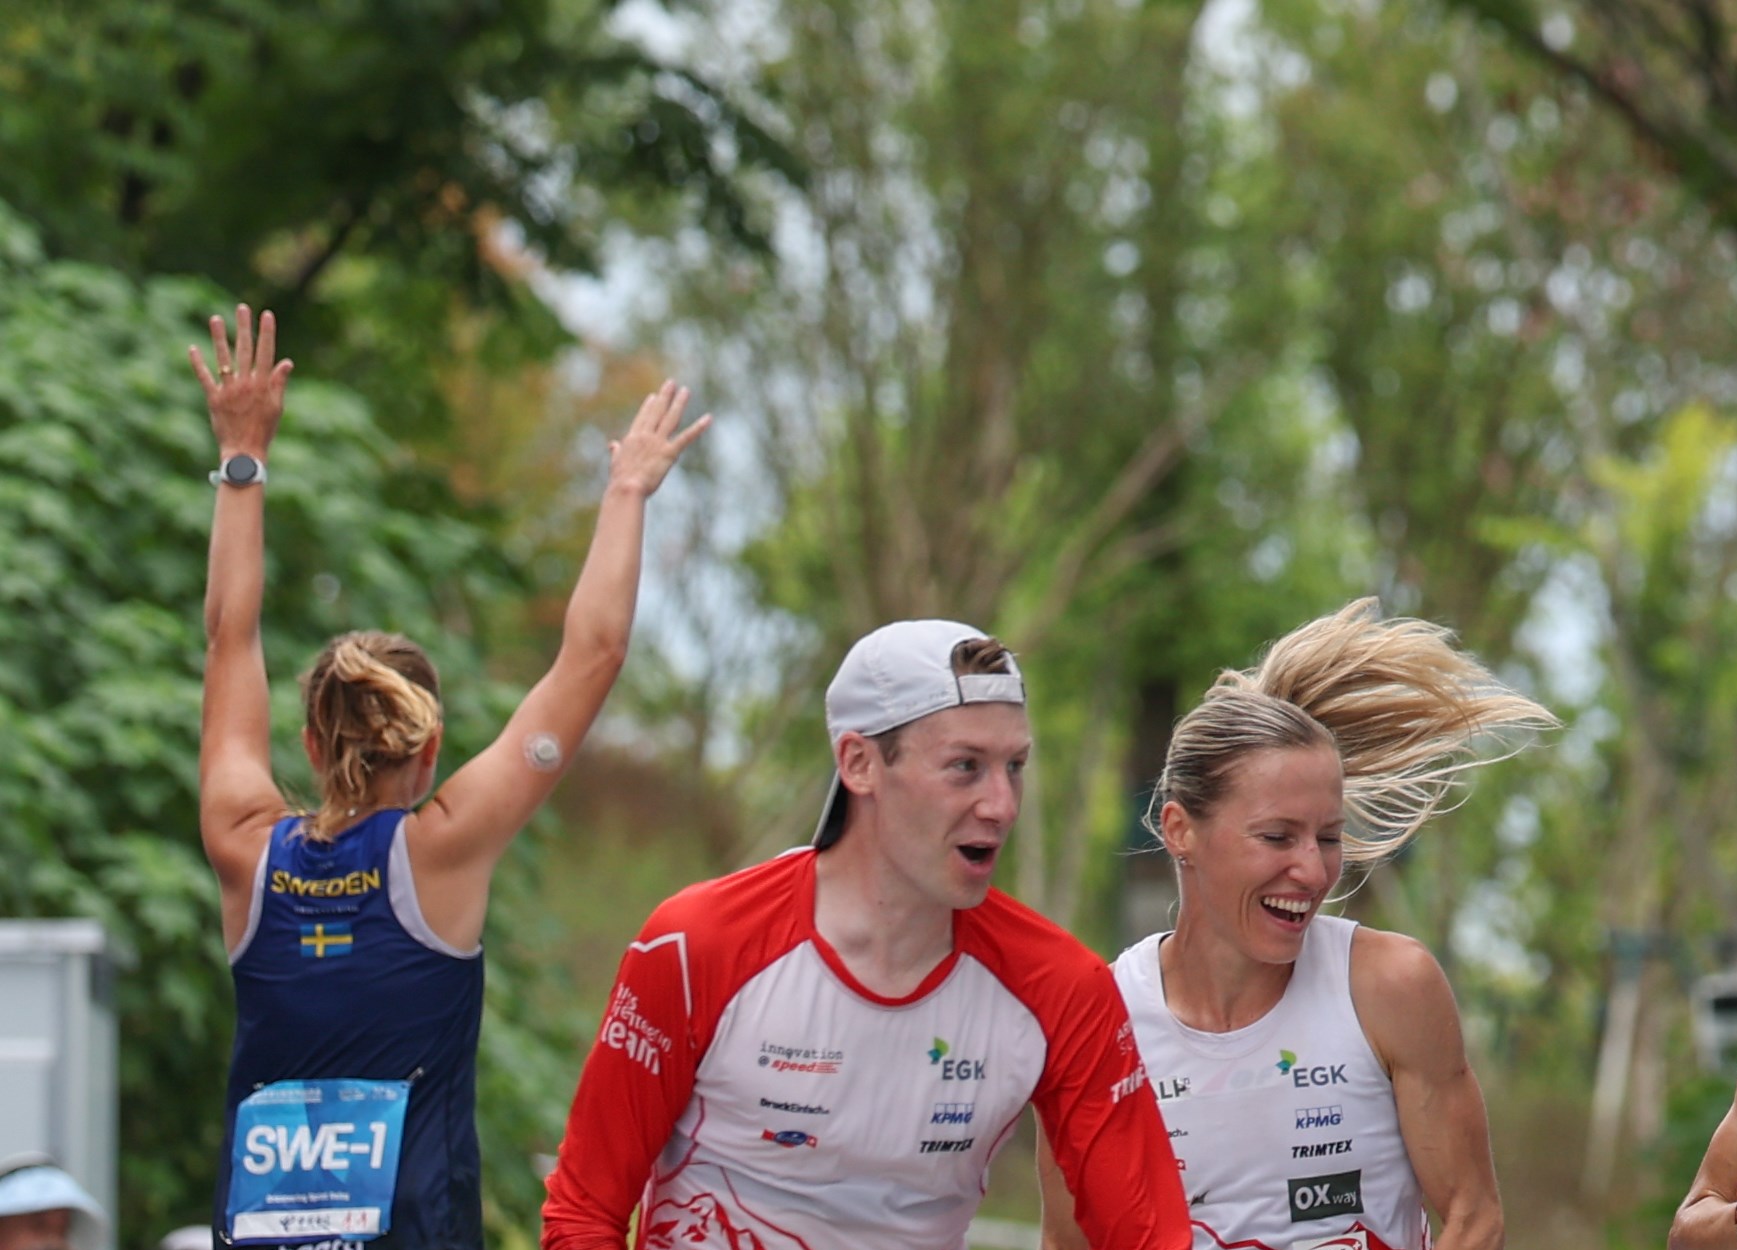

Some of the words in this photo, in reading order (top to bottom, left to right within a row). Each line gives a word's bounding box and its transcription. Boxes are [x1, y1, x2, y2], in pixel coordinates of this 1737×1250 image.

[271, 867, 381, 897] SWEDEN
[760, 1041, 844, 1060] innovation
[772, 1060, 816, 1073] speed
[942, 1059, 987, 1081] EGK
[1293, 1063, 1349, 1088] EGK
[930, 1111, 974, 1124] KPMG
[1295, 1113, 1342, 1130] KPMG
[243, 1121, 388, 1175] SWE-1
[1291, 1139, 1353, 1159] TRIMTEX
